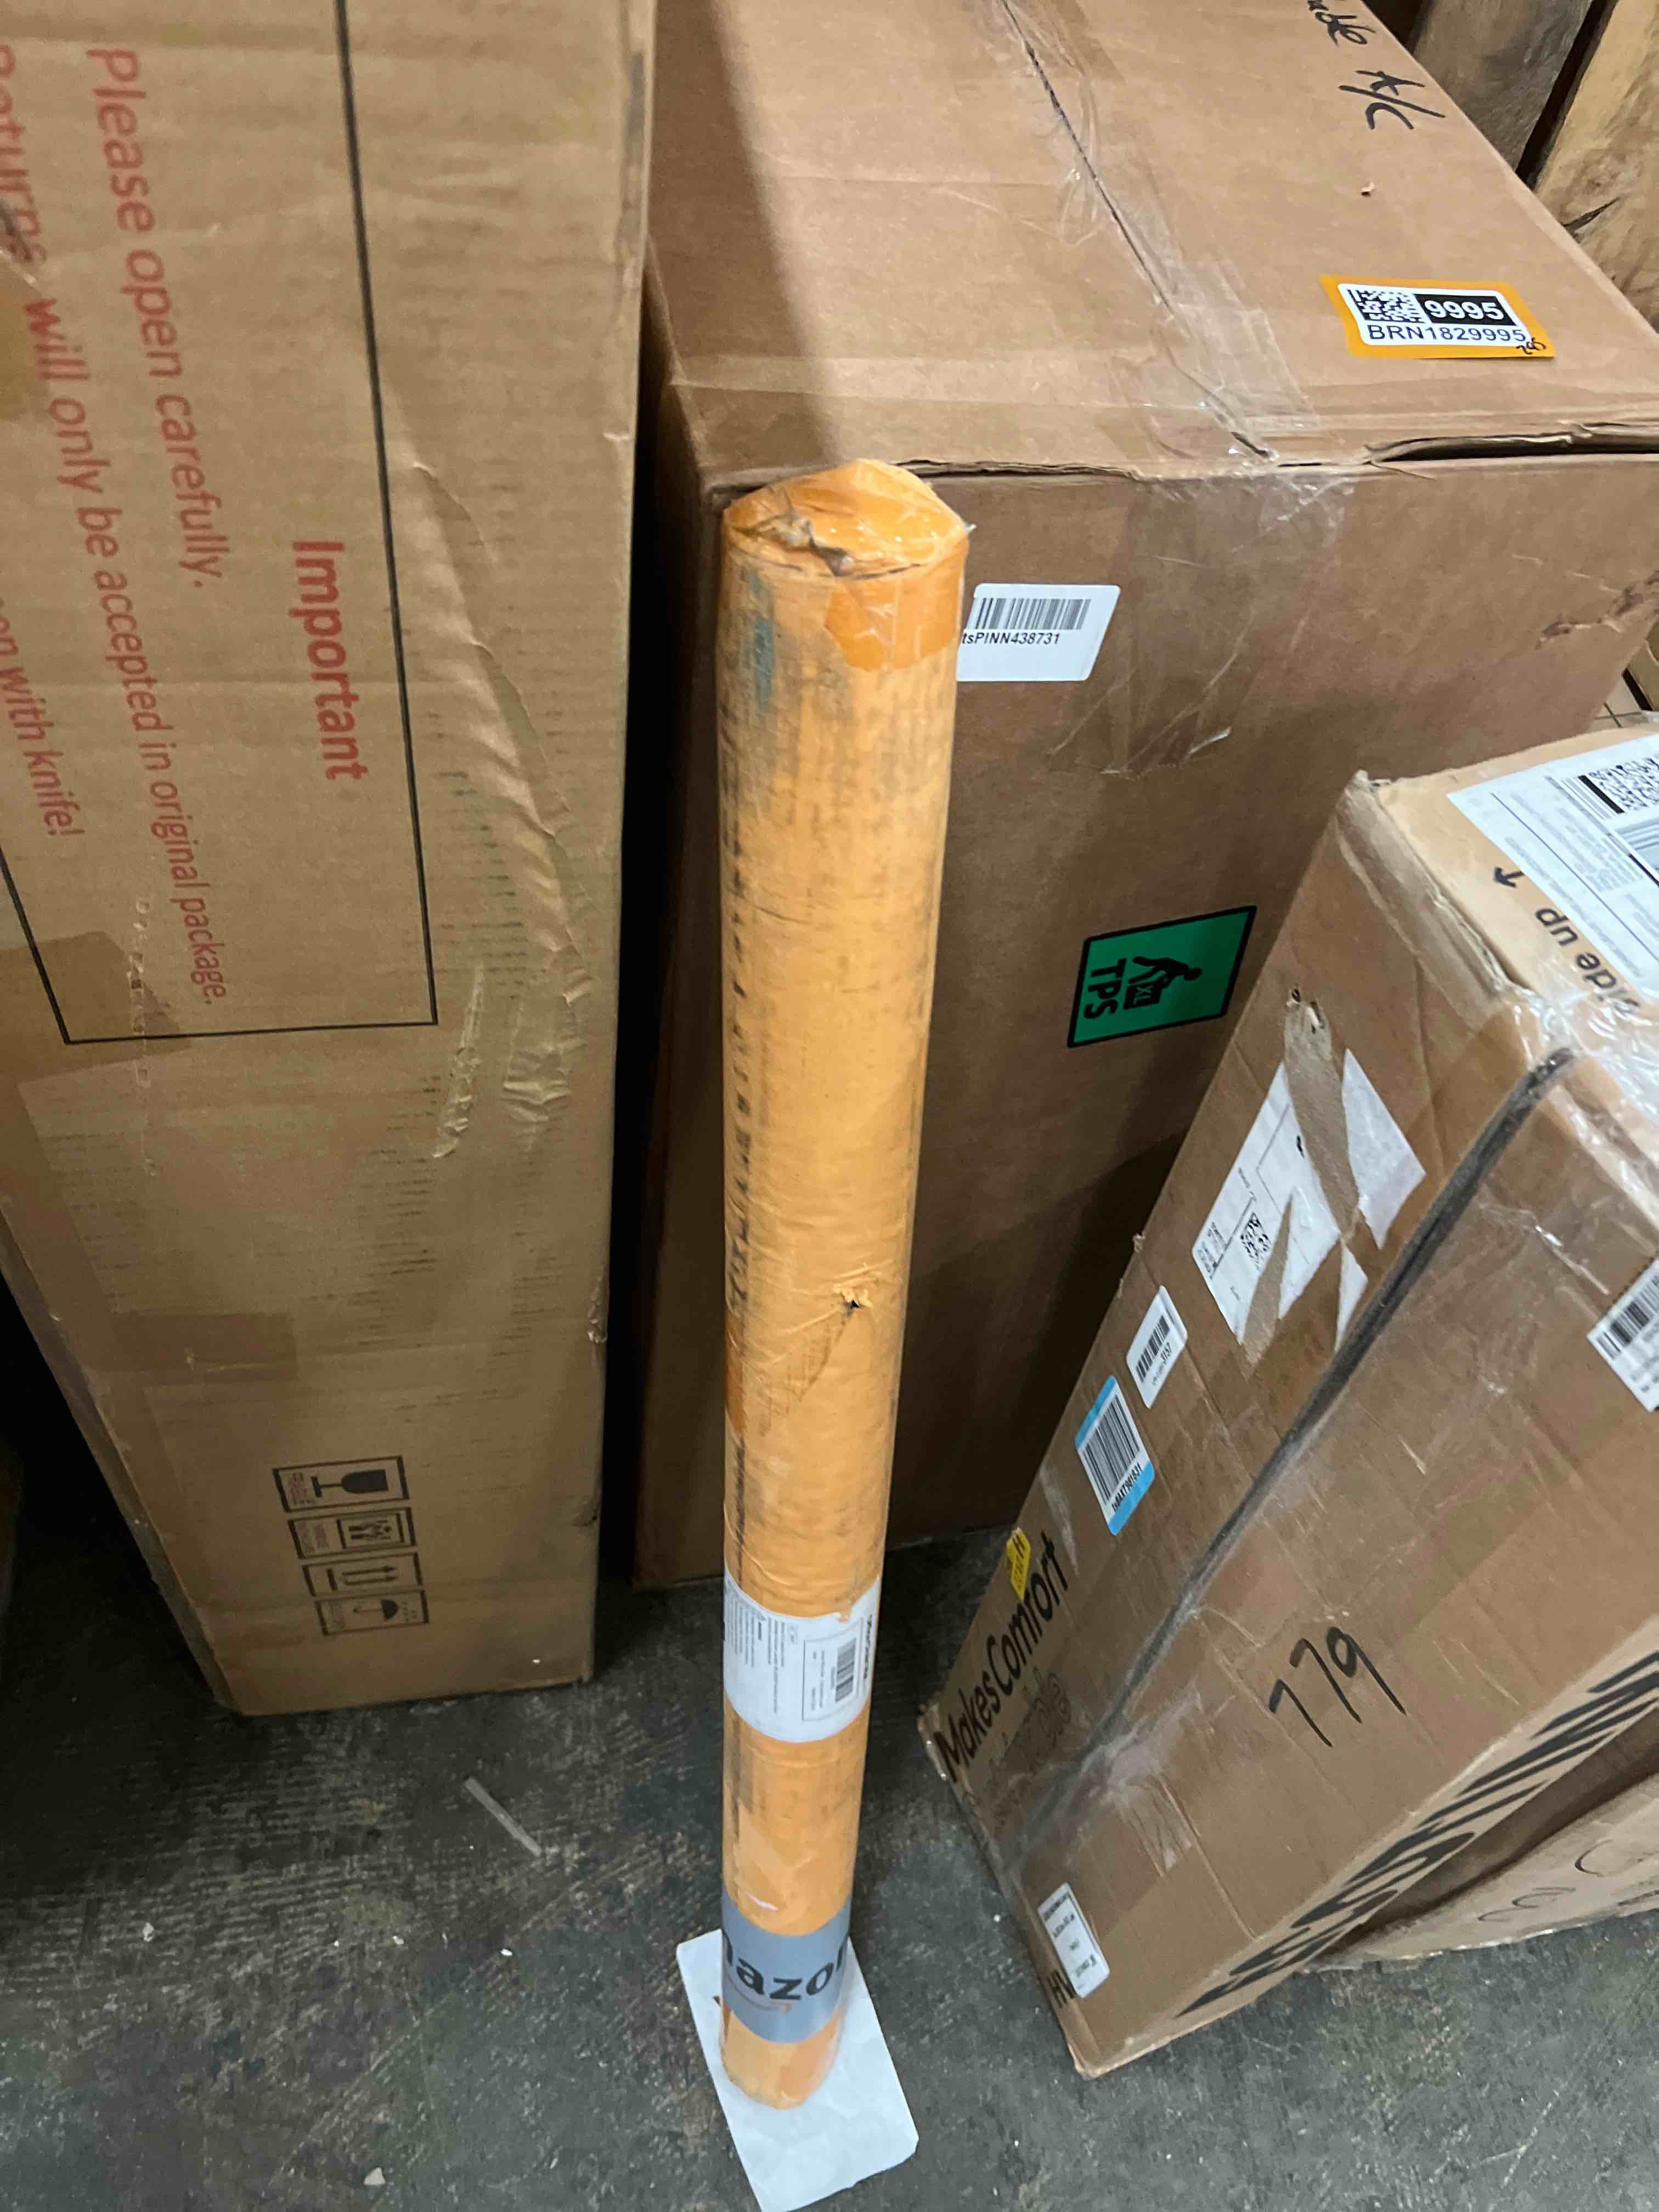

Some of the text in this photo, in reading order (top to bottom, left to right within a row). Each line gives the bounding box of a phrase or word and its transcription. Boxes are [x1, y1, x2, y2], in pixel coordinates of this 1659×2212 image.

[25, 298, 89, 381] will
[87, 49, 229, 587] Please open carefully.
[1368, 325, 1526, 342] BRN1829995
[1425, 300, 1504, 320] 9995
[47, 397, 111, 493] only
[77, 506, 122, 559] be
[93, 570, 173, 731] accepted
[291, 541, 368, 780] Important
[0, 667, 54, 740] with
[24, 750, 85, 836] knife!
[139, 740, 171, 773] in
[150, 782, 210, 888] original
[170, 896, 226, 1005] package.
[1535, 907, 1578, 947] up
[1084, 958, 1126, 1019] TPS
[1268, 1626, 1407, 1748] 779
